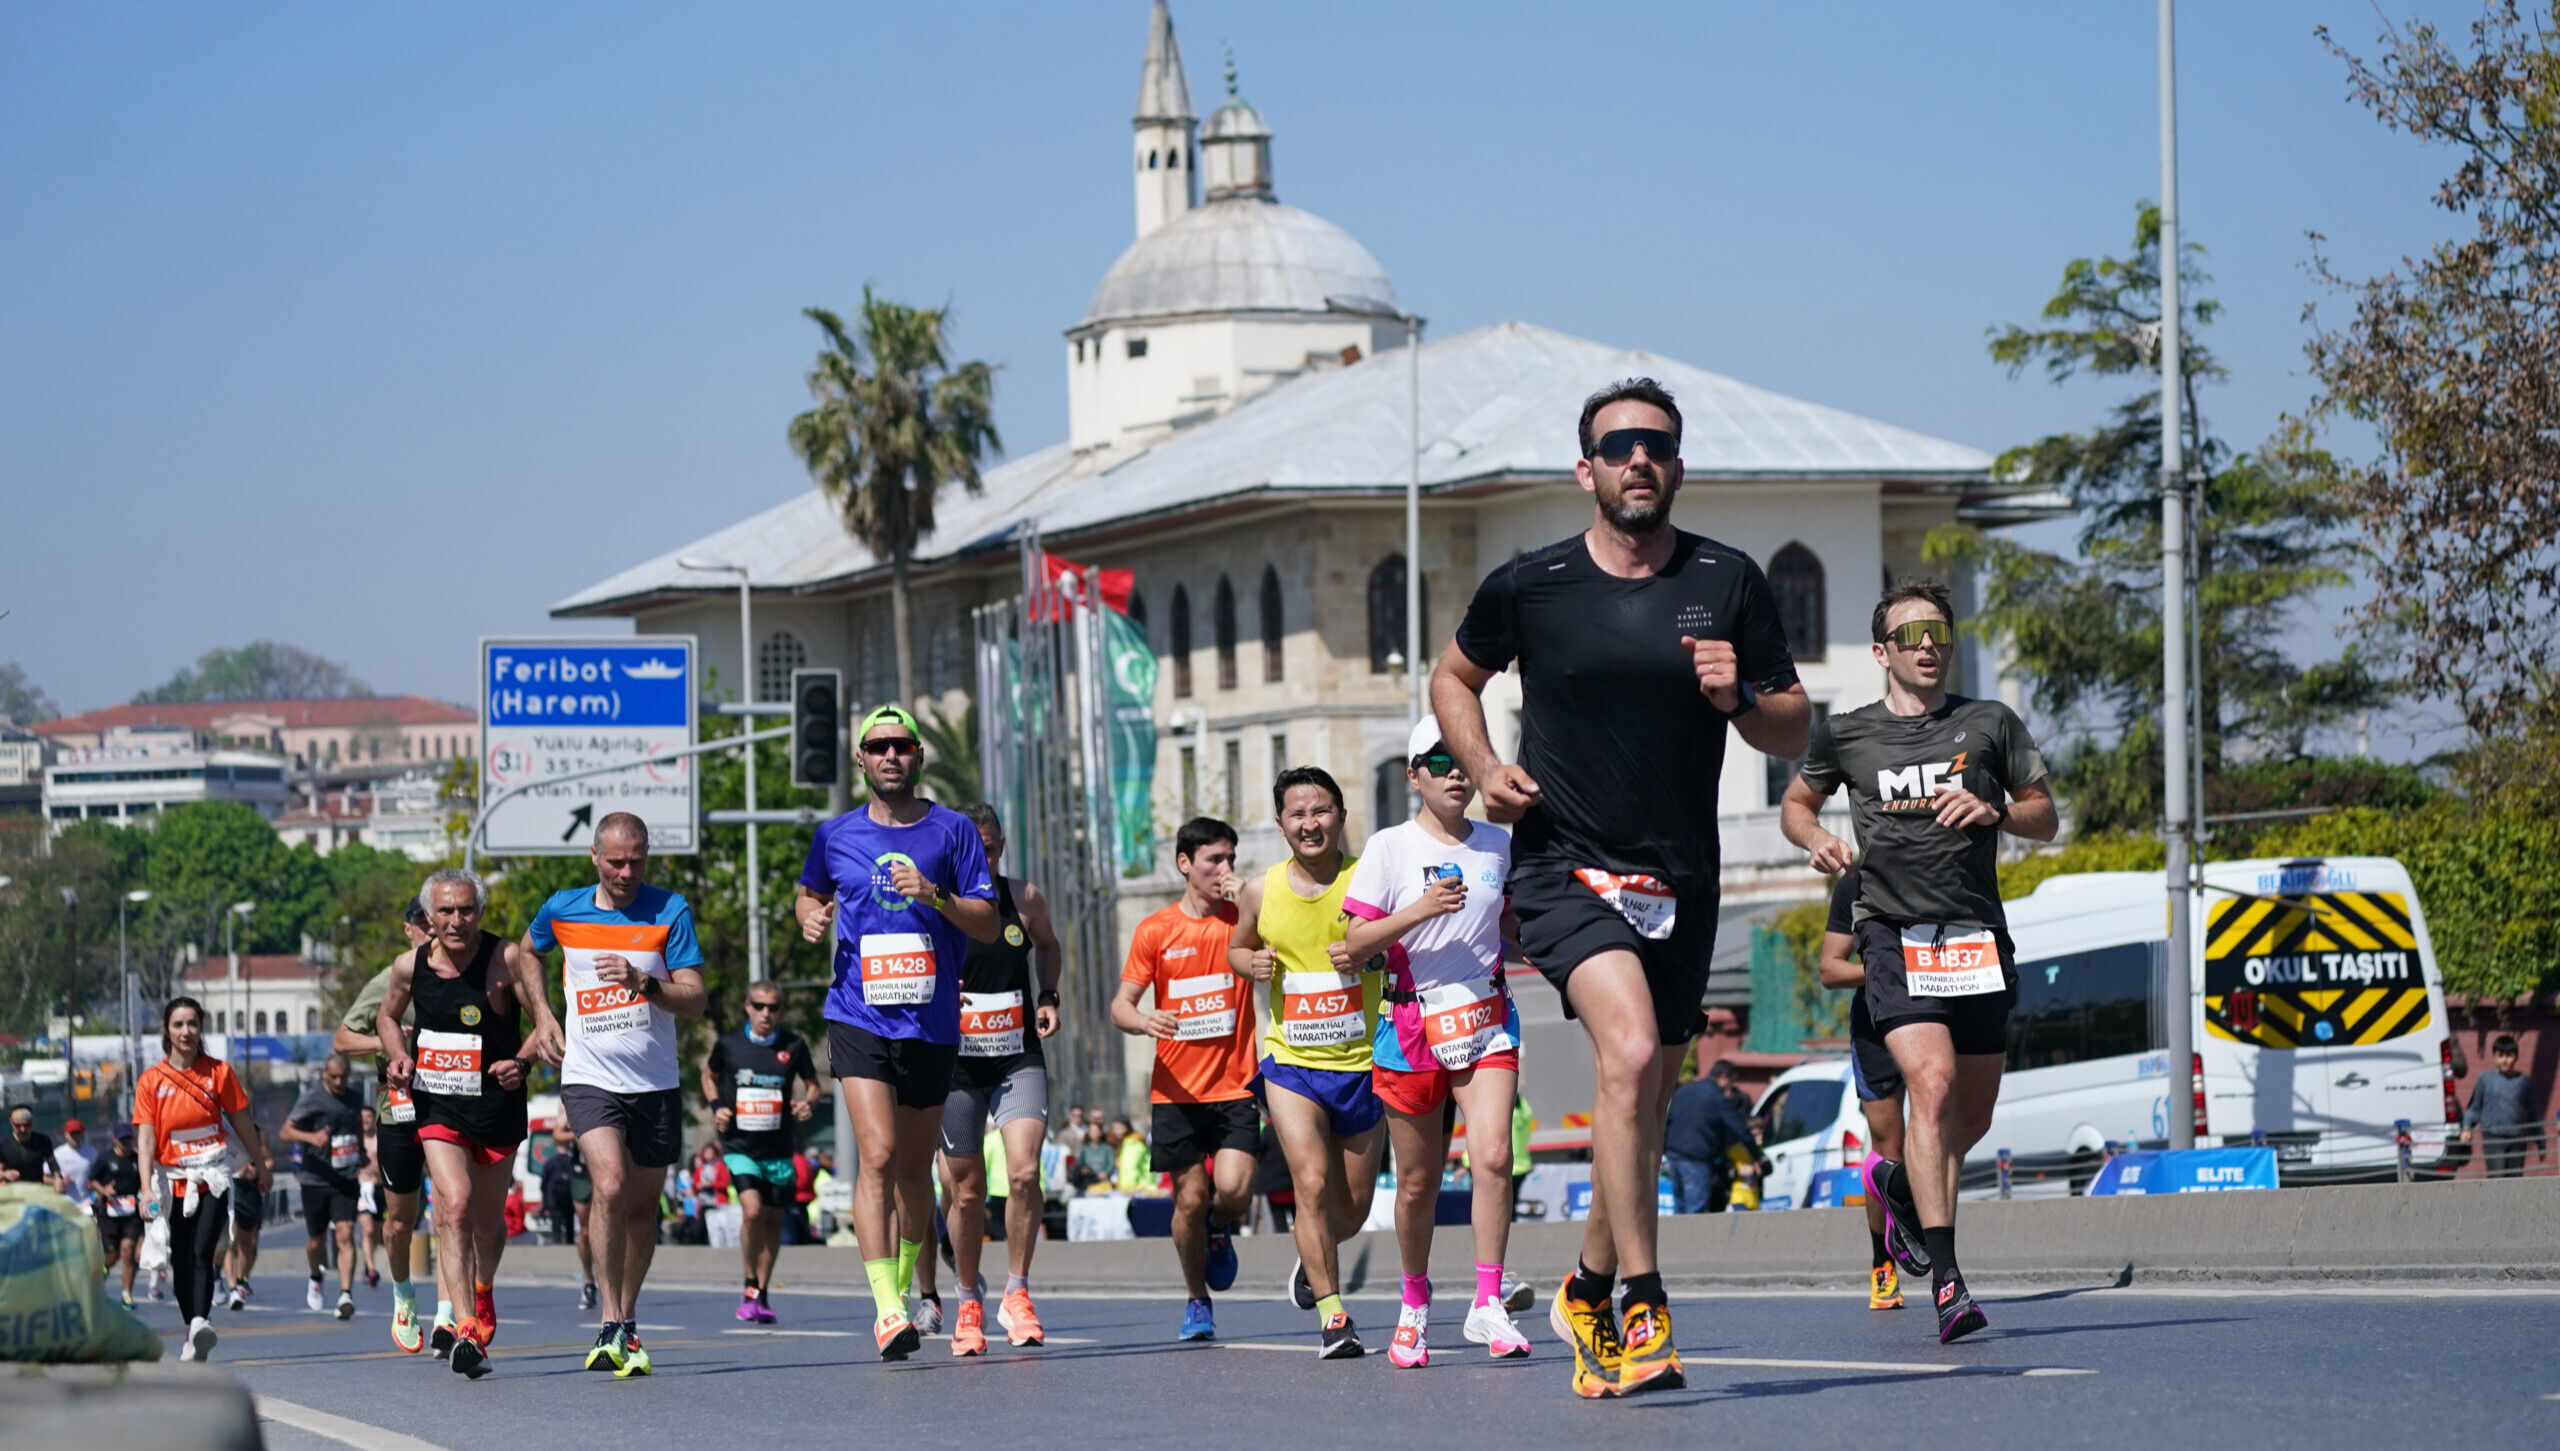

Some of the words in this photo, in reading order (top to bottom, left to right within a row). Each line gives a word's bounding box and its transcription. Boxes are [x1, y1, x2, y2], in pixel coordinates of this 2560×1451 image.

[495, 656, 612, 682] Feribot
[492, 689, 621, 720] (Harem)
[1882, 797, 1938, 811] ENDURA
[870, 959, 883, 975] B
[886, 957, 927, 974] 1428
[1917, 950, 1933, 967] B
[1936, 949, 1983, 968] 1837
[2244, 956, 2318, 985] OKUL
[2321, 952, 2409, 985] TAŞITI
[870, 991, 918, 1000] MARATHON
[1920, 984, 1980, 993] MARATHON
[581, 992, 592, 1009] C
[1180, 1000, 1193, 1014] A
[1195, 995, 1226, 1012] 865
[1296, 998, 1312, 1014] A
[1315, 994, 1349, 1013] 457
[586, 1021, 633, 1034] MARATHON
[969, 1014, 983, 1030] A
[986, 1013, 1014, 1029] 694
[1327, 1020, 1345, 1029] HALF
[1440, 1015, 1457, 1035] B
[1459, 1005, 1492, 1030] 1192
[1180, 1025, 1223, 1036] MARATHON
[1294, 1031, 1347, 1041] MARATHON
[965, 1045, 1009, 1053] MARATHON
[423, 1051, 433, 1065] F
[435, 1053, 472, 1069] 5245
[422, 1081, 464, 1092] MARATHON
[2196, 1166, 2245, 1183] ELITE
